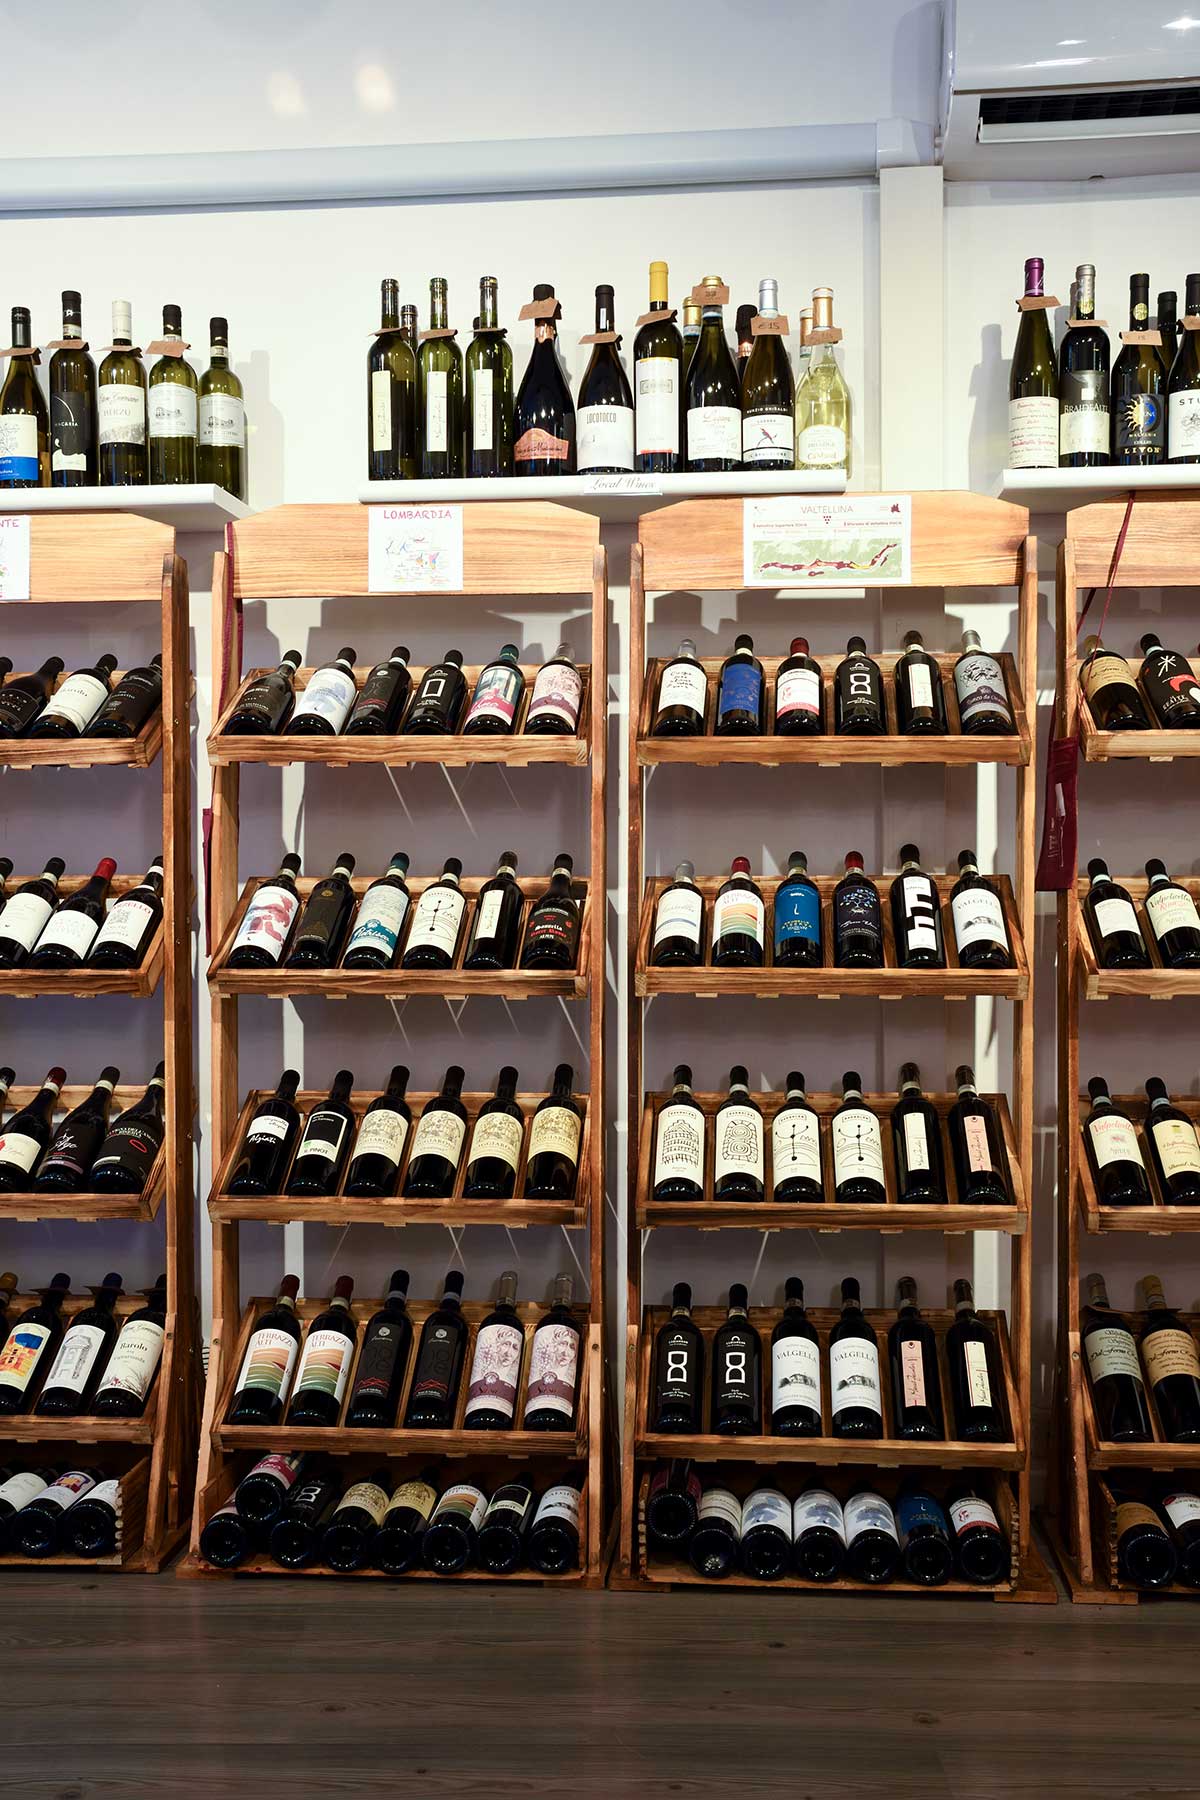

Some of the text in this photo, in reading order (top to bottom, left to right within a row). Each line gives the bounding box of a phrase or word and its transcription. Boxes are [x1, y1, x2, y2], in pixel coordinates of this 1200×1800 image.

[1124, 446, 1161, 454] LIVON
[800, 505, 854, 514] VALTELLINA
[383, 510, 452, 520] LOMBARDIA
[120, 1341, 148, 1351] Barolo
[775, 1349, 818, 1363] VALGELLA
[834, 1350, 876, 1363] VALGELLA
